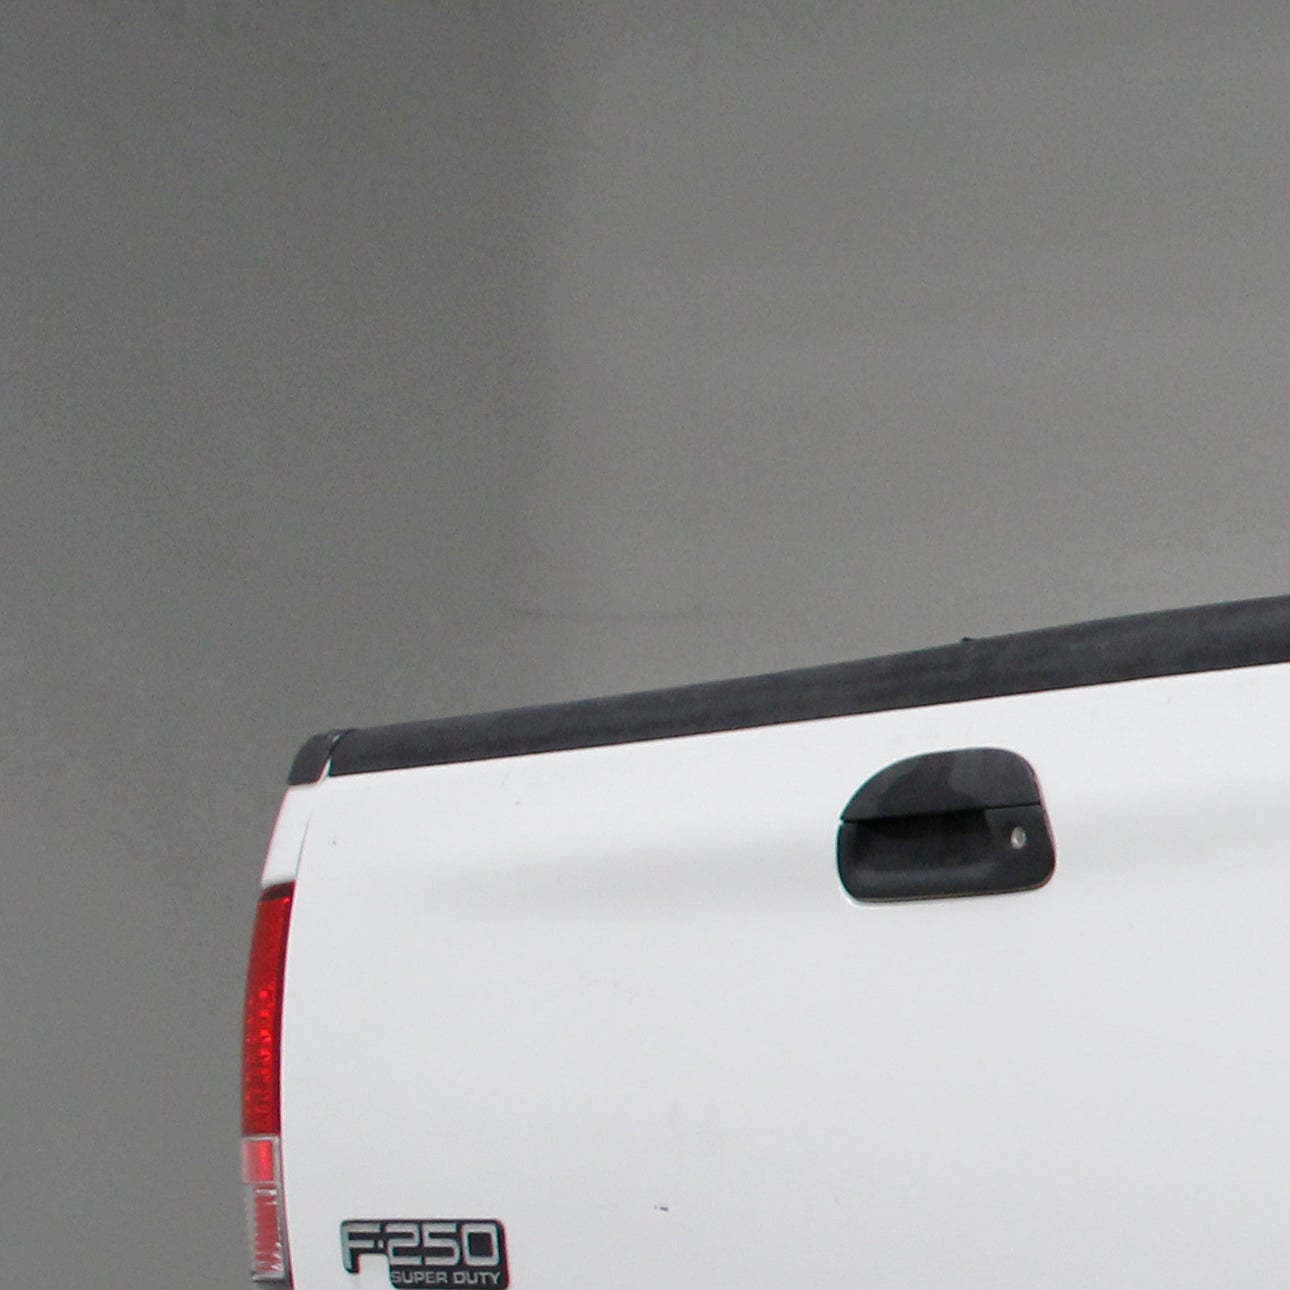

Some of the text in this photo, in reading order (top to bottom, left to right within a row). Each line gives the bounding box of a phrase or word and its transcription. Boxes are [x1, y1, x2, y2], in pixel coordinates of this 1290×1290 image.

[340, 1221, 500, 1271] F-250
[391, 1270, 500, 1284] SUPER DUTY
